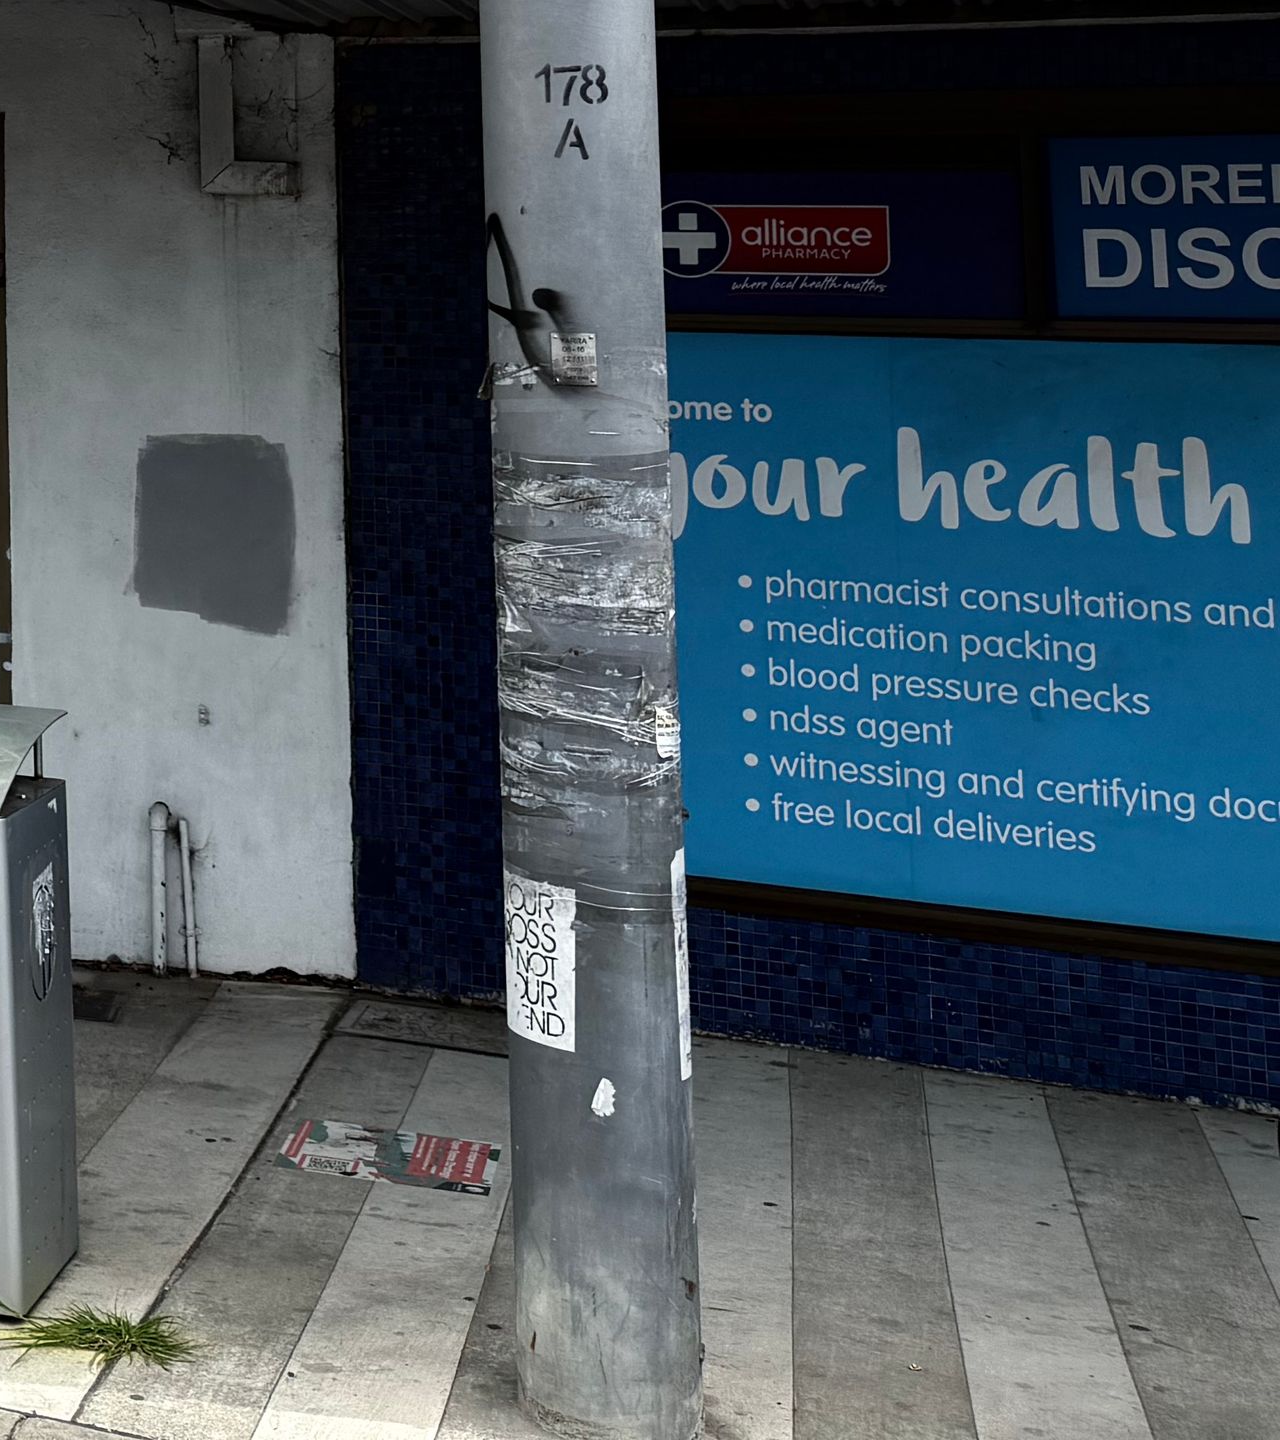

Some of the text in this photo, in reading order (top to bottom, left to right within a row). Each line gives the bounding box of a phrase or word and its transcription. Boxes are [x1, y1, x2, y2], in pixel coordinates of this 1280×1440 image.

[534, 63, 609, 106] 178
[554, 118, 589, 160] A
[1079, 163, 1280, 205] MORE
[741, 218, 872, 246] alliance
[762, 247, 851, 259] PHARMACY
[731, 276, 888, 293] where local health matters
[741, 398, 772, 423] to
[897, 426, 1251, 544] health
[765, 568, 1275, 630] pharmacist consultations and
[766, 617, 1097, 671] medication packing
[767, 657, 1152, 716] blood pressure checks
[769, 704, 953, 748] ndss agent
[769, 751, 1280, 823] witnessing and certifying doc
[772, 792, 1097, 853] free local deliveries
[508, 883, 555, 921] OUR
